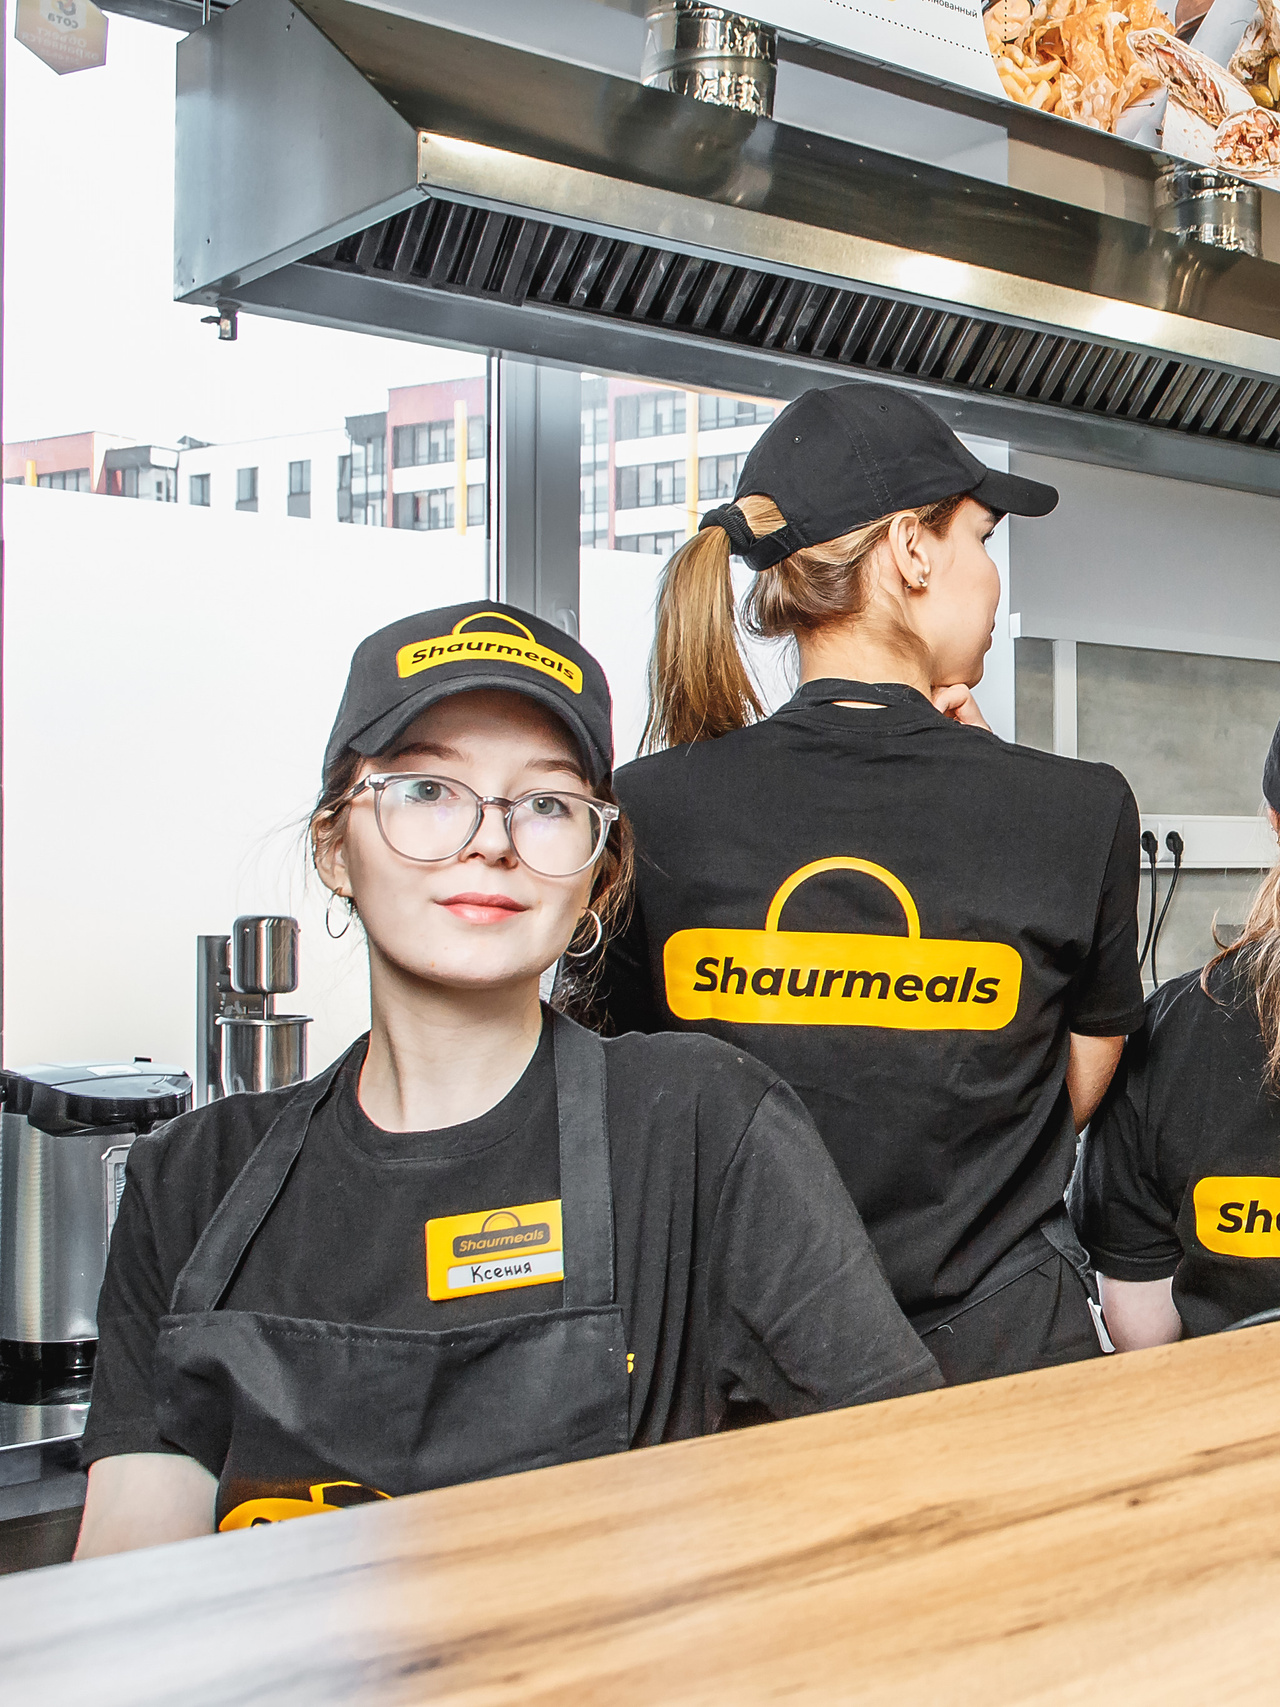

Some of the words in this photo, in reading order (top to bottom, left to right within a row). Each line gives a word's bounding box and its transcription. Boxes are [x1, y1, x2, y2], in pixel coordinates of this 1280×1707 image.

[411, 641, 574, 681] Shaurmeals
[693, 956, 1000, 1004] Shaurmeals
[459, 1229, 544, 1253] Shaurmeals
[470, 1261, 533, 1284] Ксения
